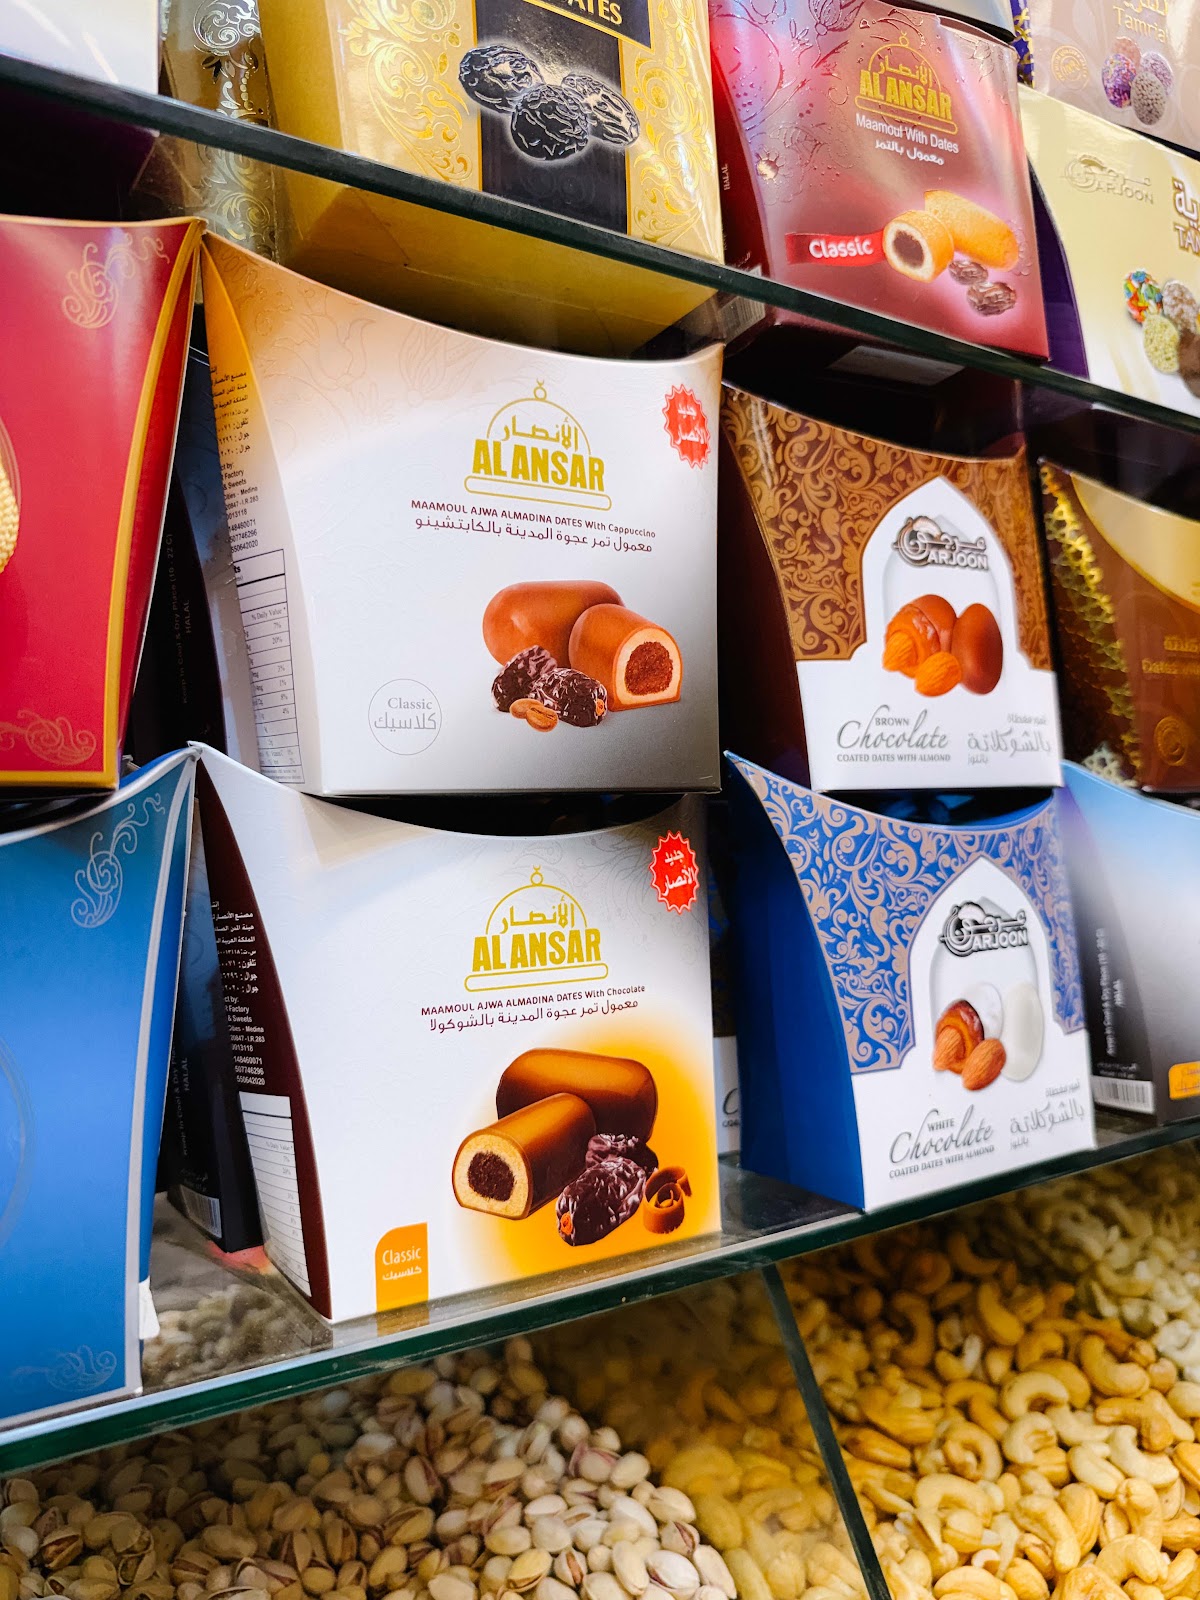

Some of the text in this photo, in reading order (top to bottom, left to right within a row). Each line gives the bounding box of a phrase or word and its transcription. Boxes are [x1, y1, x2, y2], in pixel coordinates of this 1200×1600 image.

[566, 0, 623, 25] ATES
[859, 69, 953, 121] AL ANSAR
[855, 112, 960, 155] Maamoul With Dates
[874, 139, 945, 167] معمول بالتمر
[721, 163, 731, 191] HALAL
[808, 235, 875, 259] Classic
[501, 415, 580, 452] الأنصار
[224, 469, 245, 480] Factory
[472, 438, 605, 493] AL ANSAR
[228, 478, 247, 490] Sweets
[240, 486, 259, 496] Medina
[411, 499, 657, 539] MAAMOUL AJWA ALMADINA DATES With Cappuccino
[415, 515, 653, 553] معمول تمر عجوة المدينة بالكابتشينو
[183, 599, 192, 634] HALAL
[387, 697, 433, 710] Classic
[373, 711, 437, 732] كلاسيك
[836, 704, 949, 749] Chocolate
[875, 717, 910, 727] BROWN
[836, 753, 951, 763] COATED DATES WITH ALMOND
[500, 895, 575, 934] الأنصار
[472, 927, 602, 972] AL ANSAR
[228, 1004, 250, 1015] Factory
[421, 984, 646, 1016] MAAMOUL AJWA ALMADINA DATES With Chocolate
[227, 1014, 253, 1023] & Sweets
[430, 999, 639, 1034] معمول تمر عجوة المدينة بالشوكولا
[181, 1057, 190, 1091] HALAL
[888, 1103, 993, 1164] Chocolate
[927, 1117, 955, 1133] WHITE
[888, 1144, 996, 1179] COATED DATES WITH ALMOND
[381, 1245, 423, 1266] Classic
[381, 1265, 423, 1281] كلاسيك
